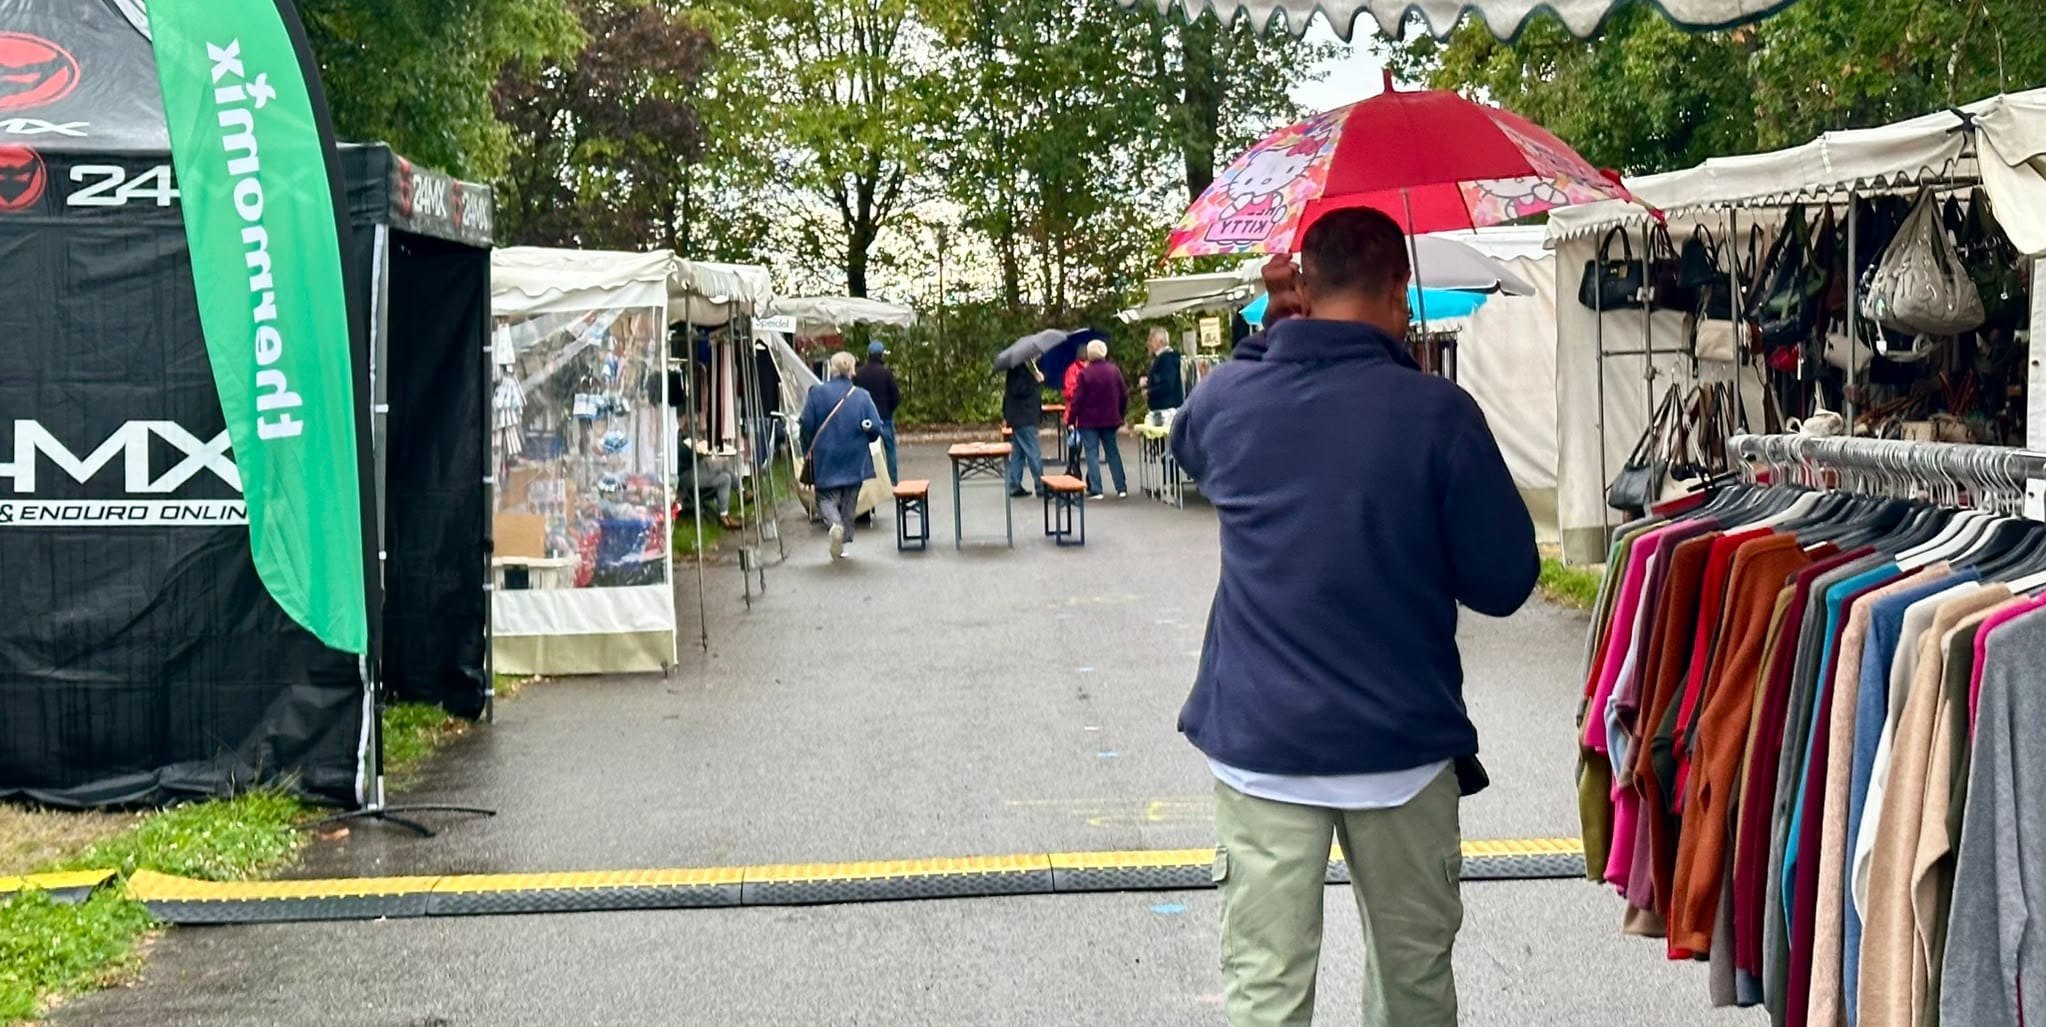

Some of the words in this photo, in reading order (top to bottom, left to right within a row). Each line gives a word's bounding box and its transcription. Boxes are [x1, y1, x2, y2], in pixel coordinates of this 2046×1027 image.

[413, 173, 447, 219] 24MX
[0, 419, 244, 493] MX
[20, 505, 149, 520] ENDURO
[160, 505, 248, 520] ONLIN
